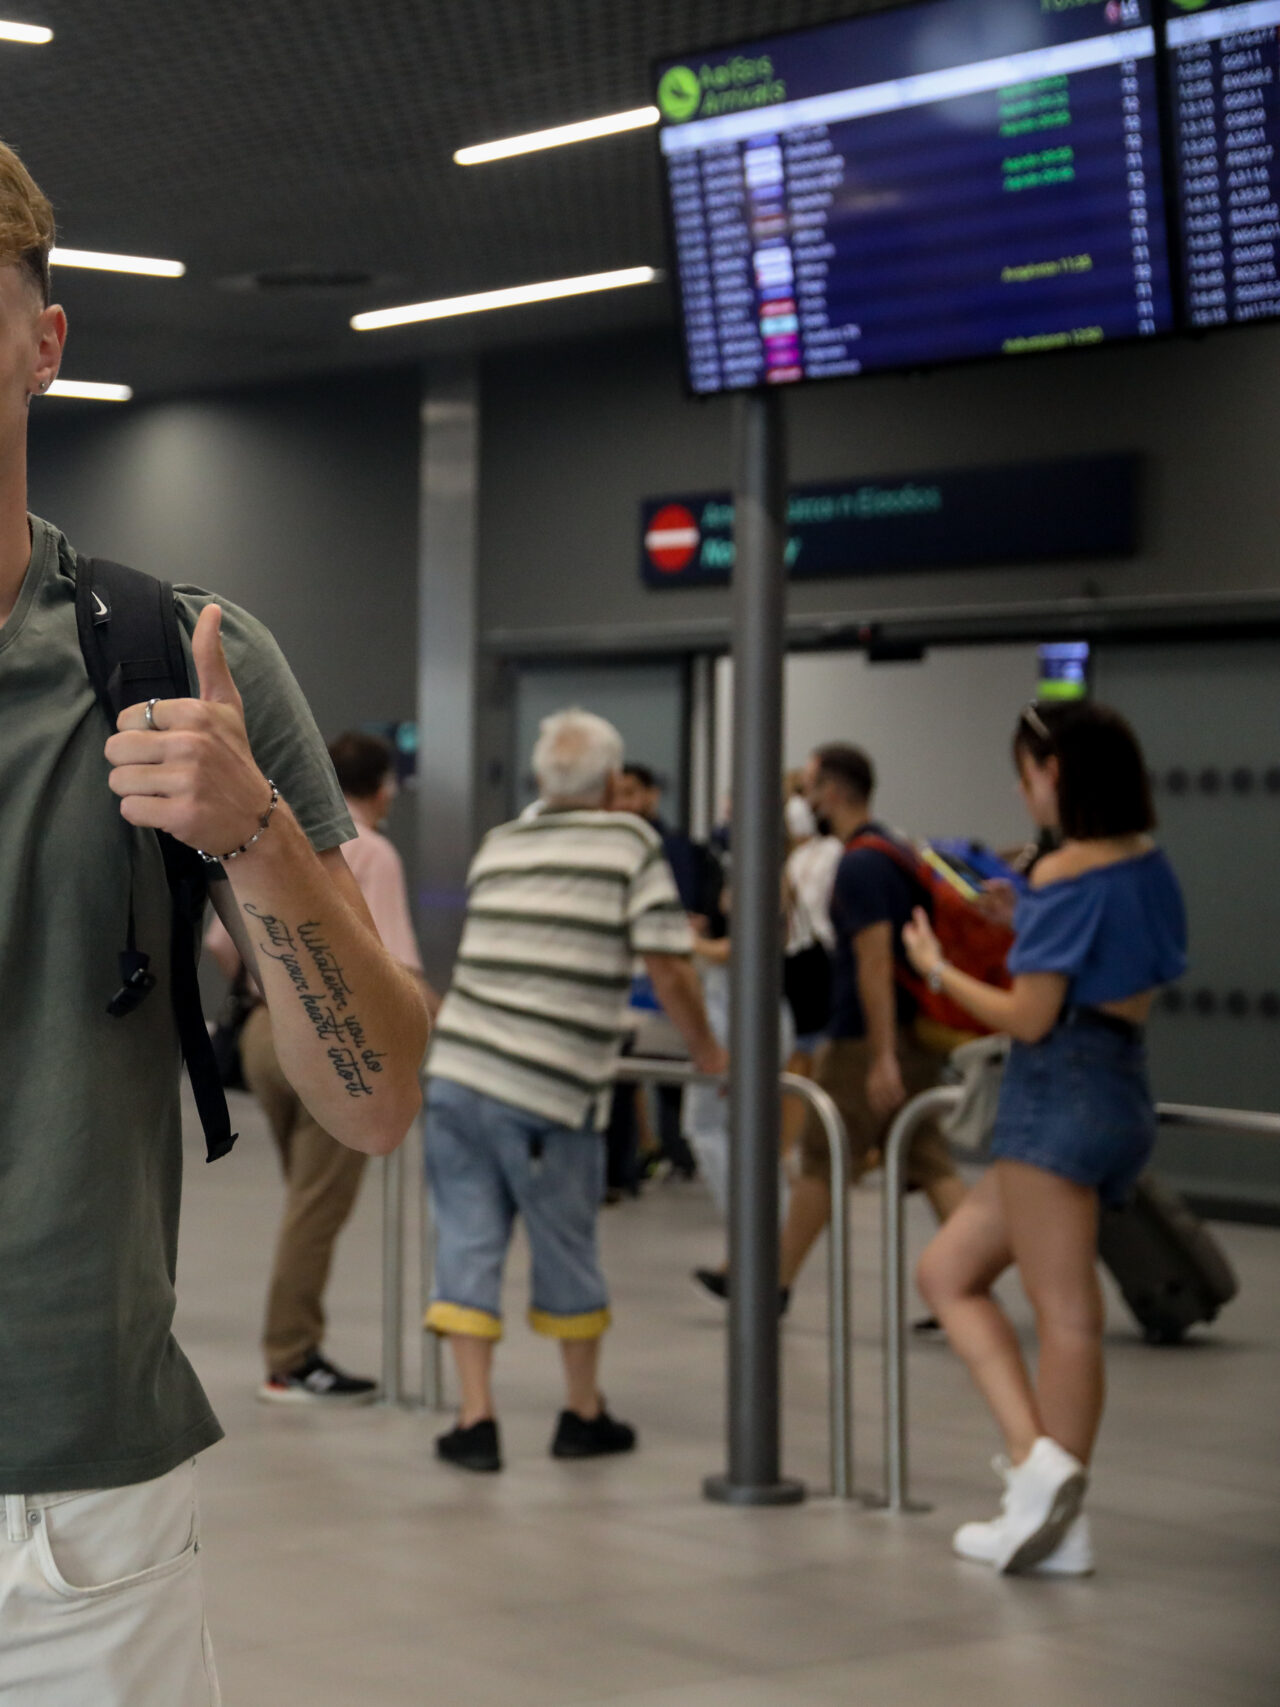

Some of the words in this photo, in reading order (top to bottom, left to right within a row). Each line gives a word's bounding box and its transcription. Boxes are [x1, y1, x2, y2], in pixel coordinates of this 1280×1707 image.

[244, 903, 297, 951] put
[260, 943, 308, 992] your
[297, 921, 352, 1010] Whatever
[342, 1015, 366, 1048] you
[361, 1049, 388, 1073] do
[299, 994, 345, 1043] heart
